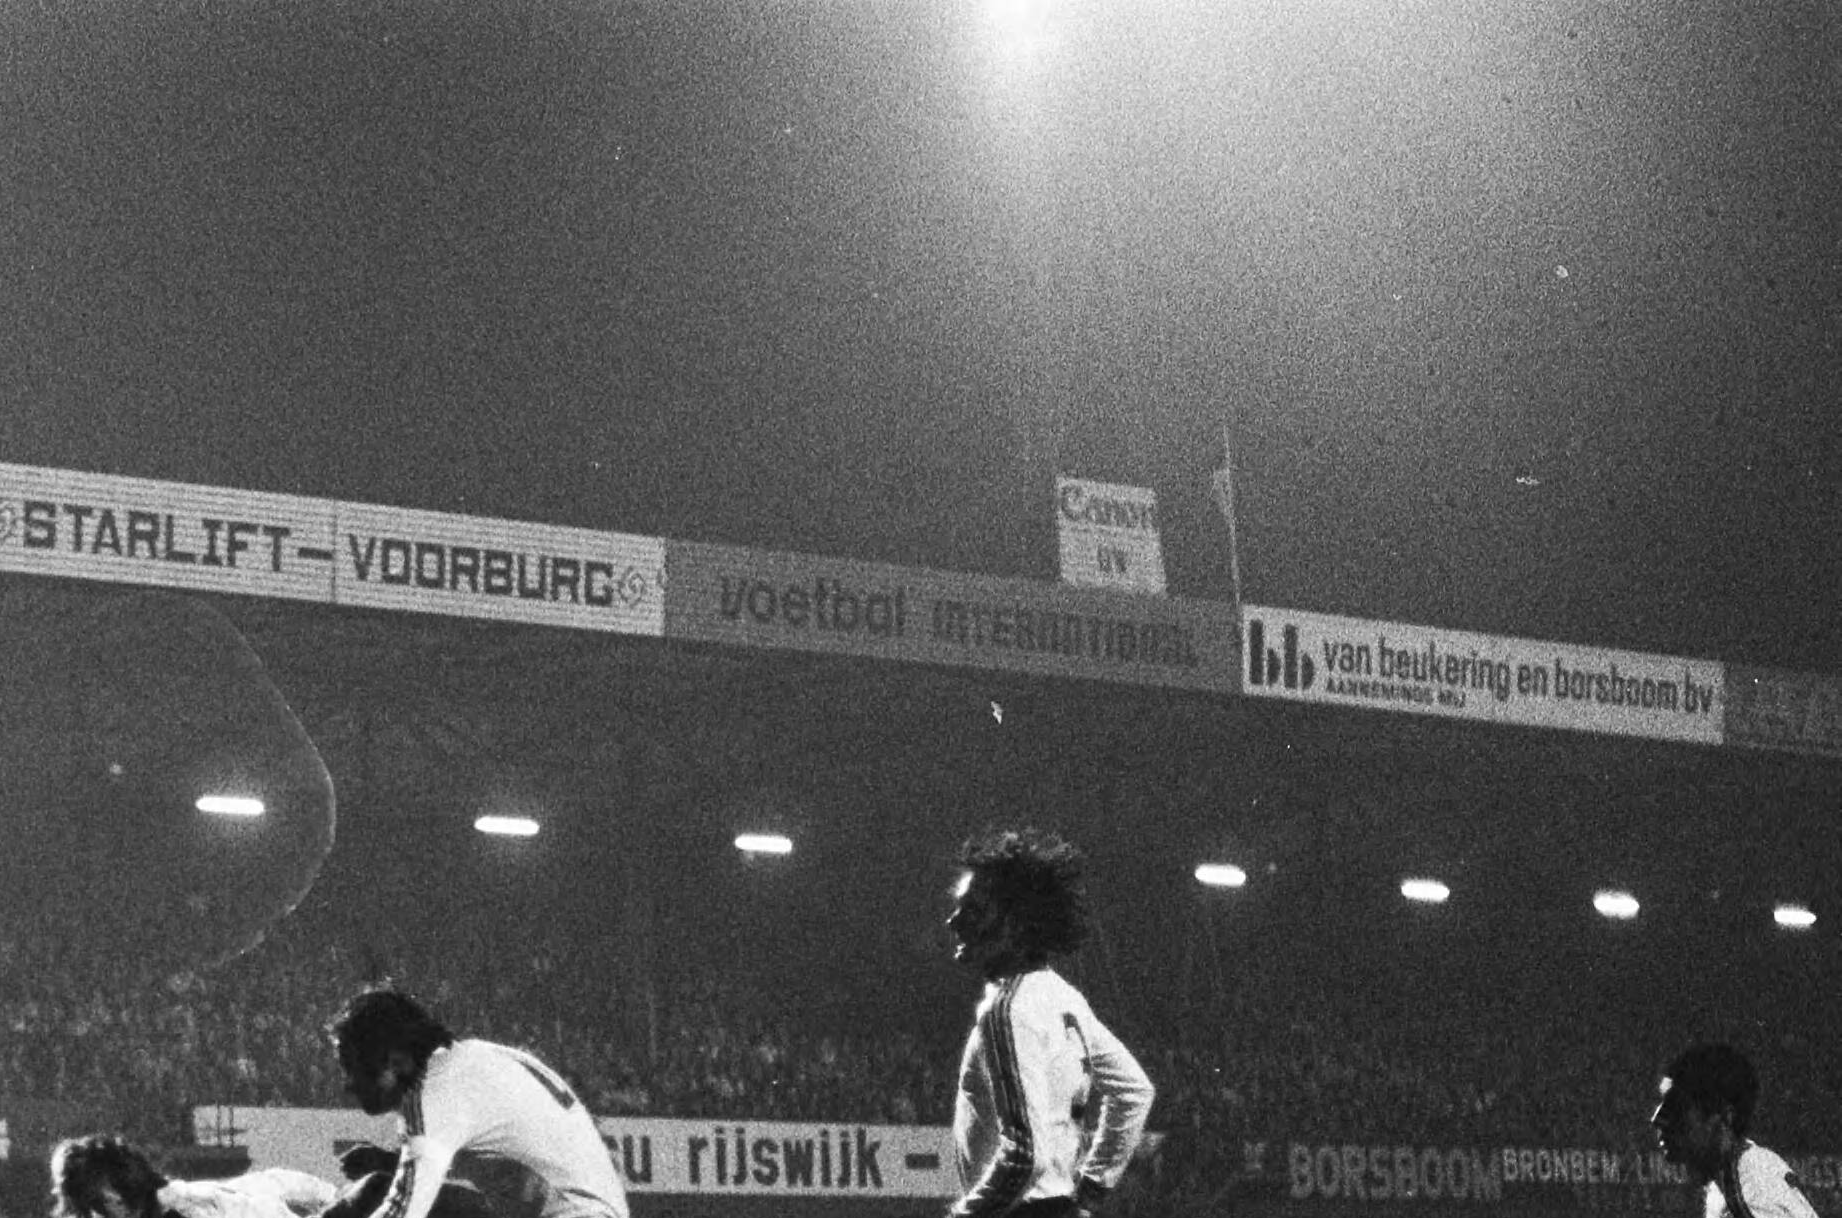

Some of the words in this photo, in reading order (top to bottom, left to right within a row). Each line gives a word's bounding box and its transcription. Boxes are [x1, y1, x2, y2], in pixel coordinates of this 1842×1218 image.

[348, 533, 615, 608] VOORBURG
[1323, 639, 1372, 676] van
[1379, 635, 1509, 702] beukering
[1516, 662, 1549, 699] en
[1555, 659, 1678, 711] borsboom
[688, 1127, 885, 1188] rijswijk
[1289, 1142, 1501, 1199] BORSBOOM
